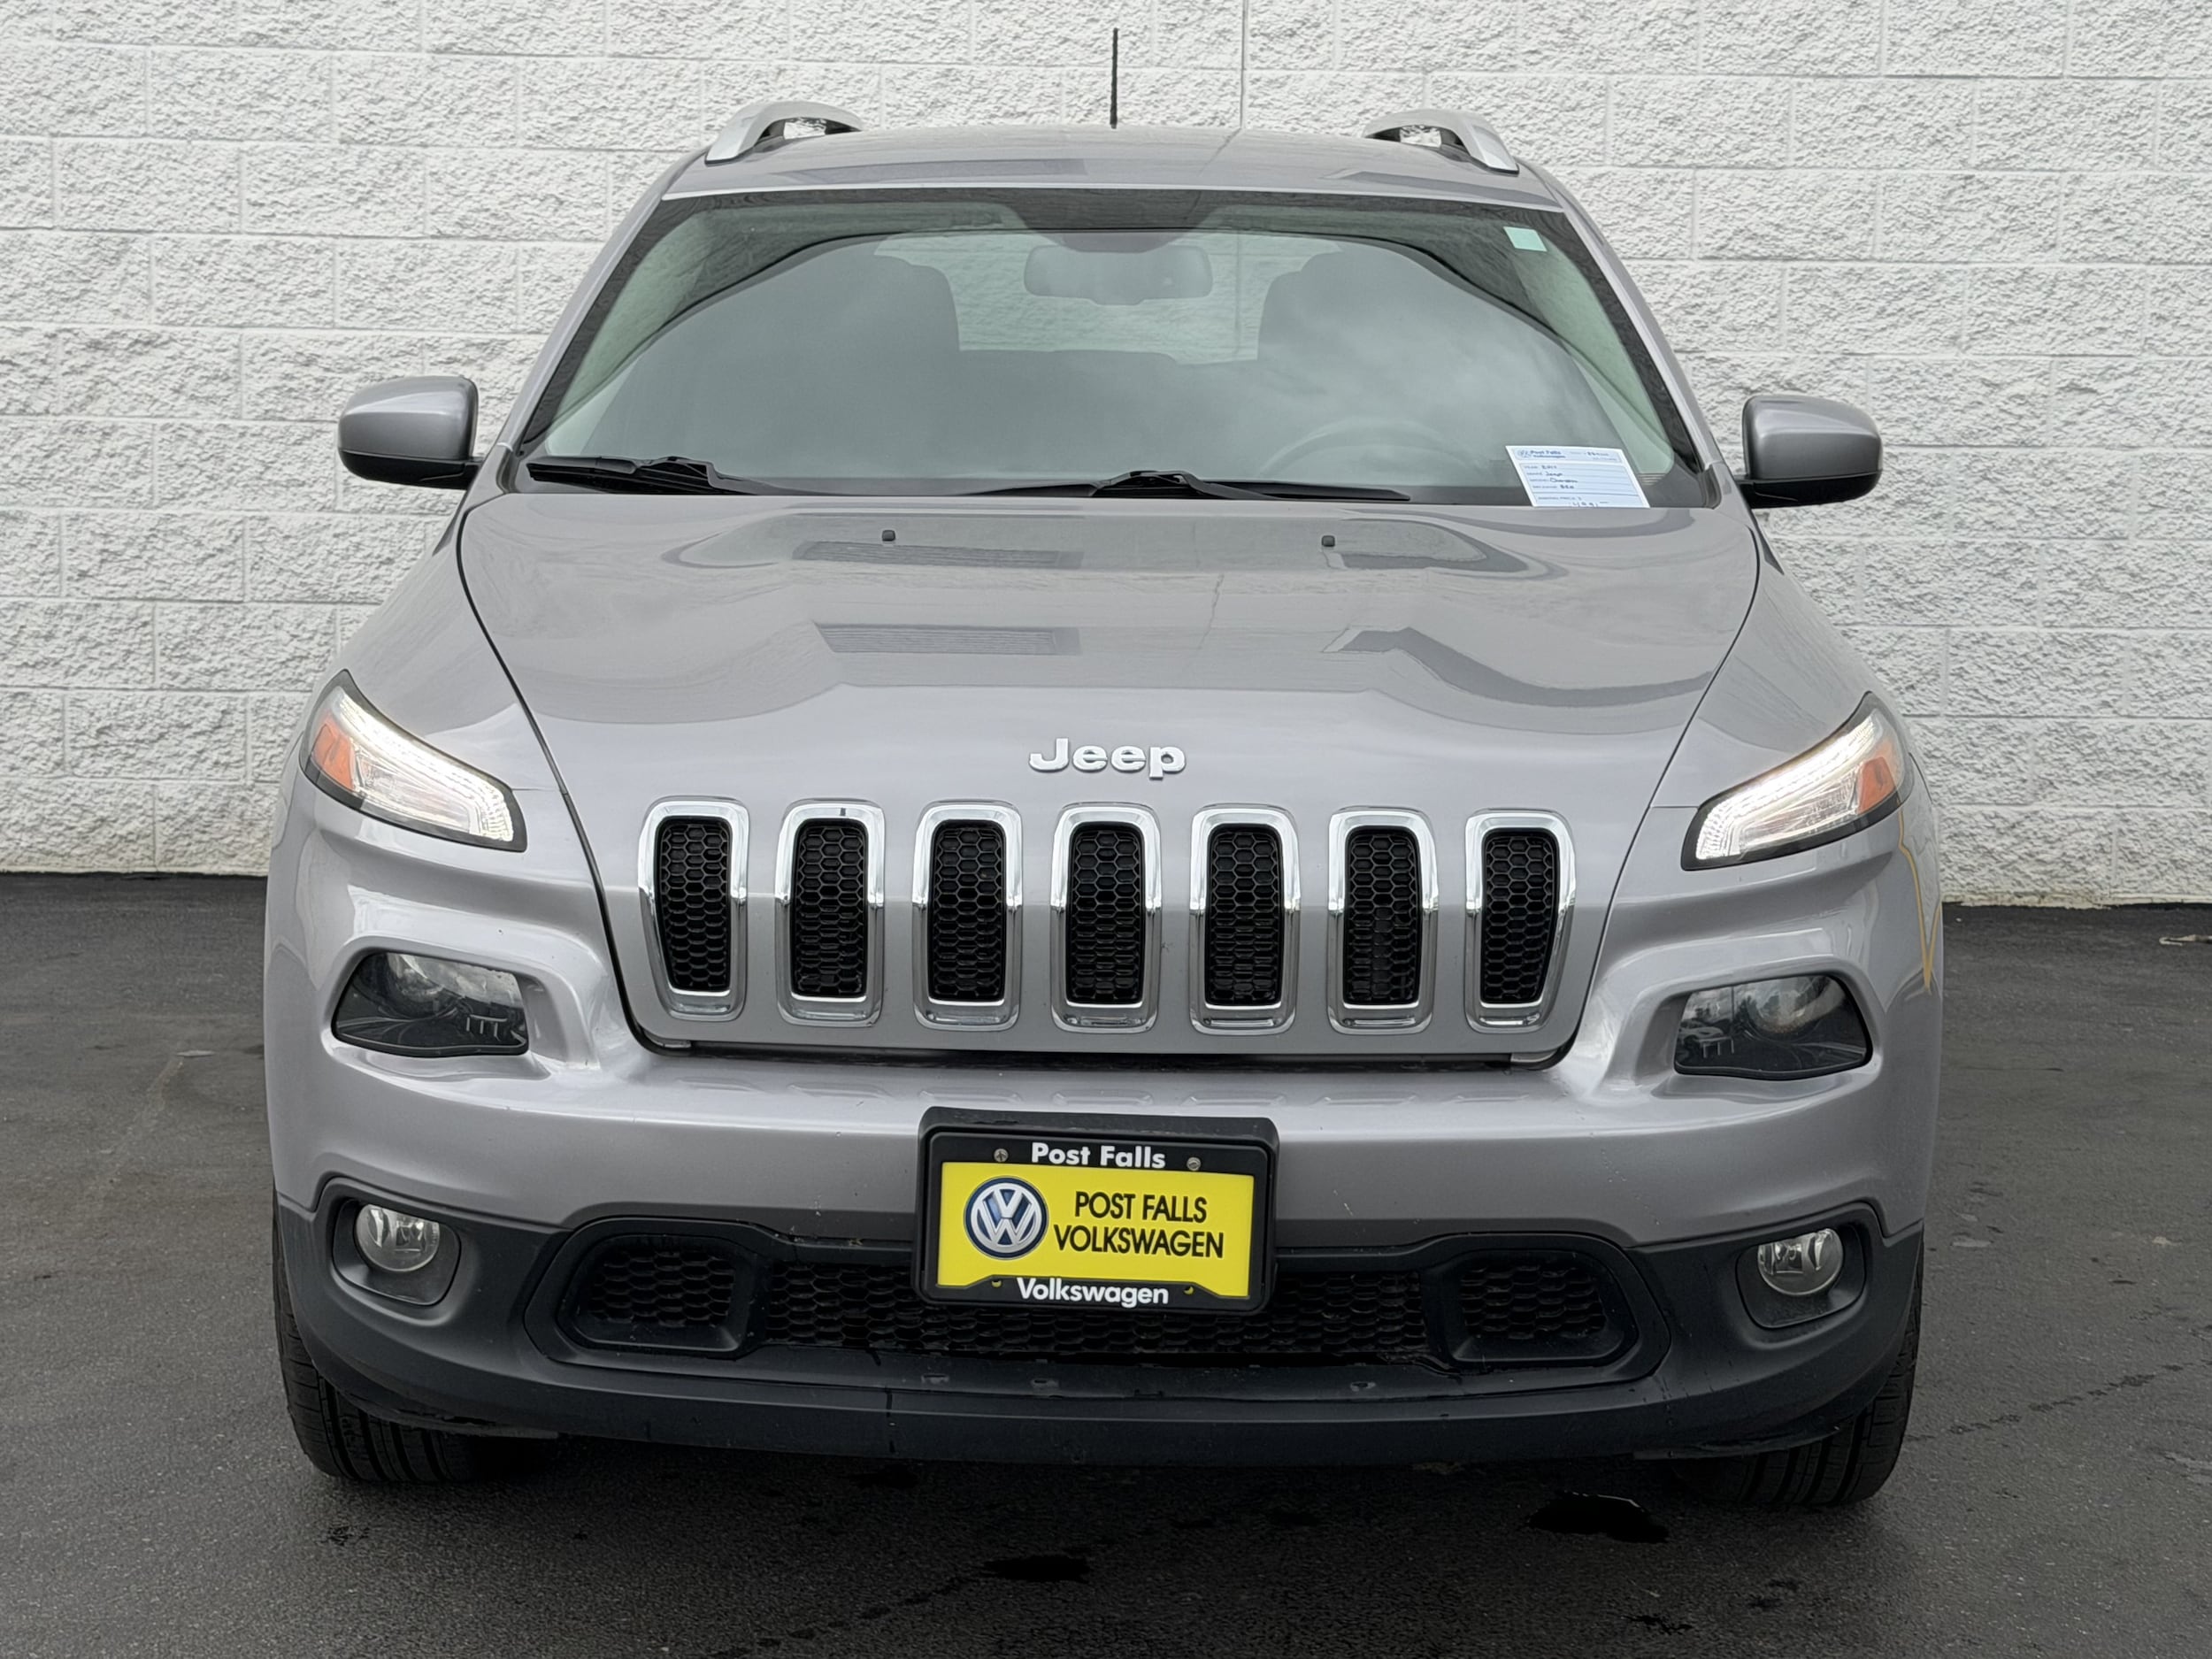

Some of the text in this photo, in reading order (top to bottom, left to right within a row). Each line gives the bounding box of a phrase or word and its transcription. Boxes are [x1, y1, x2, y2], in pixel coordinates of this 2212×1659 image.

[1029, 737, 1186, 781] Jeep
[1031, 1141, 1166, 1169] Post Falls
[1074, 1191, 1207, 1223] POST FALLS
[1053, 1225, 1224, 1258] VOLKSWAGEN
[1017, 1277, 1169, 1308] Volkswagen
